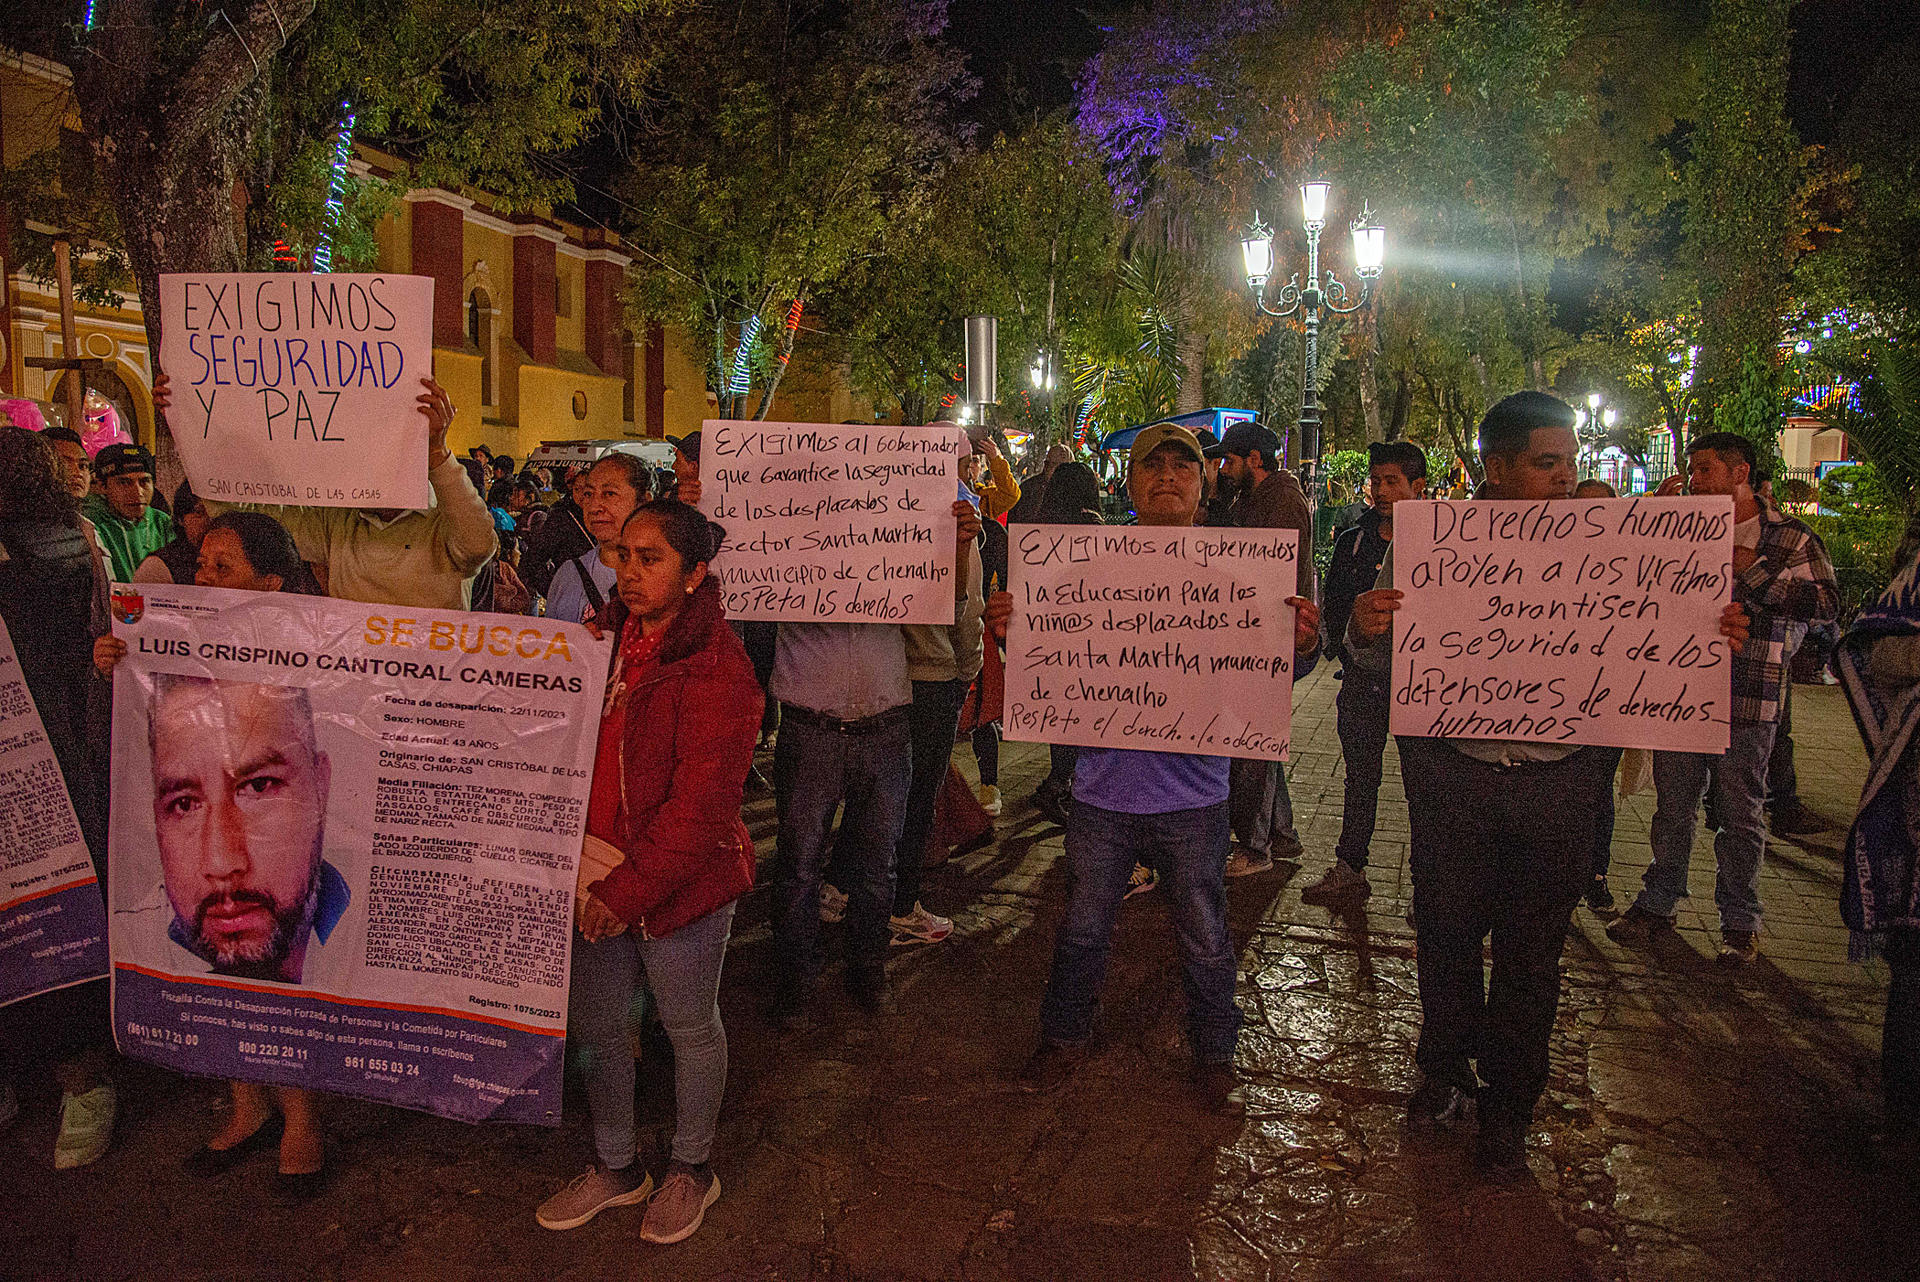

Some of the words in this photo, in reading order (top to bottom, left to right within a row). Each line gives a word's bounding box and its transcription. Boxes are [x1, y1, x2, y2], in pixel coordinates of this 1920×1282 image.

[185, 278, 396, 332] EXIGIMOS
[190, 333, 404, 389] SEGURIDAD
[195, 389, 216, 440] Y
[256, 388, 345, 442] PAZ
[845, 434, 868, 455] al
[208, 478, 231, 495] SAN
[235, 481, 298, 498] CRISTOBAL
[307, 486, 320, 499] DE
[327, 488, 345, 500] LAS
[352, 488, 381, 500] CASAS
[716, 467, 755, 492] que
[714, 495, 738, 519] de
[897, 489, 926, 512] de
[1431, 501, 1605, 545] Derechos
[1618, 498, 1732, 545] humanos
[1164, 537, 1186, 560] al
[832, 560, 858, 580] de
[1541, 561, 1563, 583] a
[1576, 554, 1628, 586] los
[813, 588, 838, 617] los
[845, 582, 914, 619] derechos
[1024, 581, 1051, 604] la
[1229, 581, 1257, 602] los
[1479, 592, 1660, 621] garantisen
[1237, 610, 1262, 629] de
[363, 616, 416, 647] SE
[429, 620, 572, 662] BUSCA
[1398, 623, 1426, 654] la
[1626, 629, 1661, 663] de
[1668, 634, 1724, 669] los
[139, 637, 190, 656] LUIS
[199, 643, 308, 668] CRISPINO
[316, 652, 451, 682] CANTORAL
[460, 667, 582, 693] CAMERAS
[1030, 676, 1052, 701] de
[1578, 666, 1612, 718] de
[384, 696, 415, 705] Fecha
[419, 699, 431, 707] de
[509, 707, 565, 719] 22/11/2023
[383, 714, 413, 723] Sexo:
[416, 717, 465, 728] HOMBRE
[1093, 708, 1118, 738] el
[1427, 707, 1583, 740] humanos
[381, 732, 408, 742] Edad
[452, 738, 465, 746] 43
[468, 739, 499, 750] AÑOS
[379, 750, 434, 763] Originario
[460, 757, 483, 766] SAN
[552, 767, 565, 775] DE
[567, 769, 586, 777] LAS
[422, 762, 472, 775] CHIAPAS
[433, 789, 487, 802] ESTATURA
[542, 802, 564, 811] PESO
[465, 785, 483, 793] TEZ
[376, 792, 427, 805] CABELLO
[554, 812, 580, 821] OJOS
[374, 815, 387, 823] DE
[390, 815, 419, 825] NARIZ
[426, 810, 468, 822] TAMAÑO
[486, 818, 513, 827] NARIZ
[558, 828, 578, 837] TIPO
[372, 840, 399, 850] LADO
[402, 841, 458, 855] IZQUIERDO
[461, 848, 477, 856] DEL
[519, 857, 558, 869] CICATRIZ
[386, 848, 419, 859] BRAZO
[485, 844, 516, 854] LUNAR
[518, 848, 554, 860] GRANDE
[557, 854, 573, 863] DEL
[370, 870, 459, 891] DENUNCIANTES
[465, 883, 486, 892] QUE
[482, 878, 539, 893] REFIEREN
[549, 889, 570, 898] LOS
[469, 995, 511, 1010] Registro:
[514, 1003, 562, 1019] 1075/2023
[344, 1056, 365, 1069] 961
[368, 1058, 388, 1071] 655
[406, 1063, 420, 1077] 24
